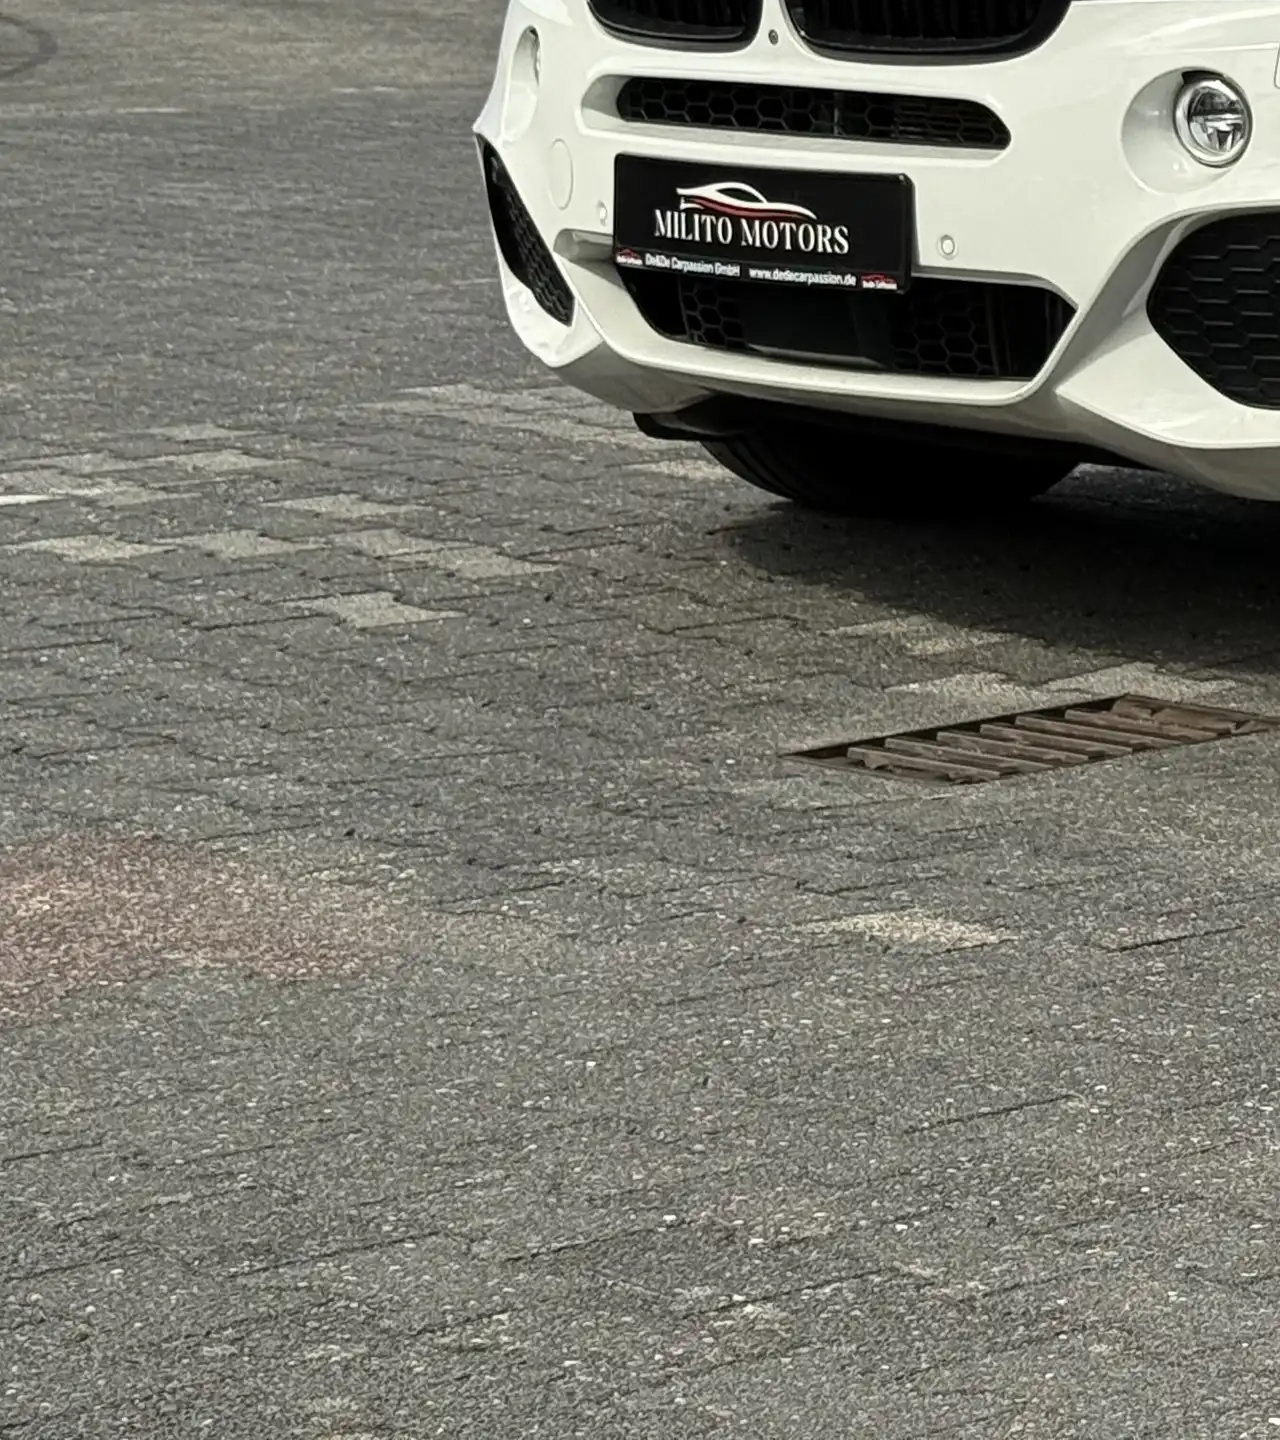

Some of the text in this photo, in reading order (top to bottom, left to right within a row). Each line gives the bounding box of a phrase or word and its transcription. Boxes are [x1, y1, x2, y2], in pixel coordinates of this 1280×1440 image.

[654, 209, 849, 255] MILITO MOTORS
[671, 256, 714, 274] Carpassion
[714, 262, 741, 277] GmbH
[748, 267, 857, 287] www.dedecarpassion.de
